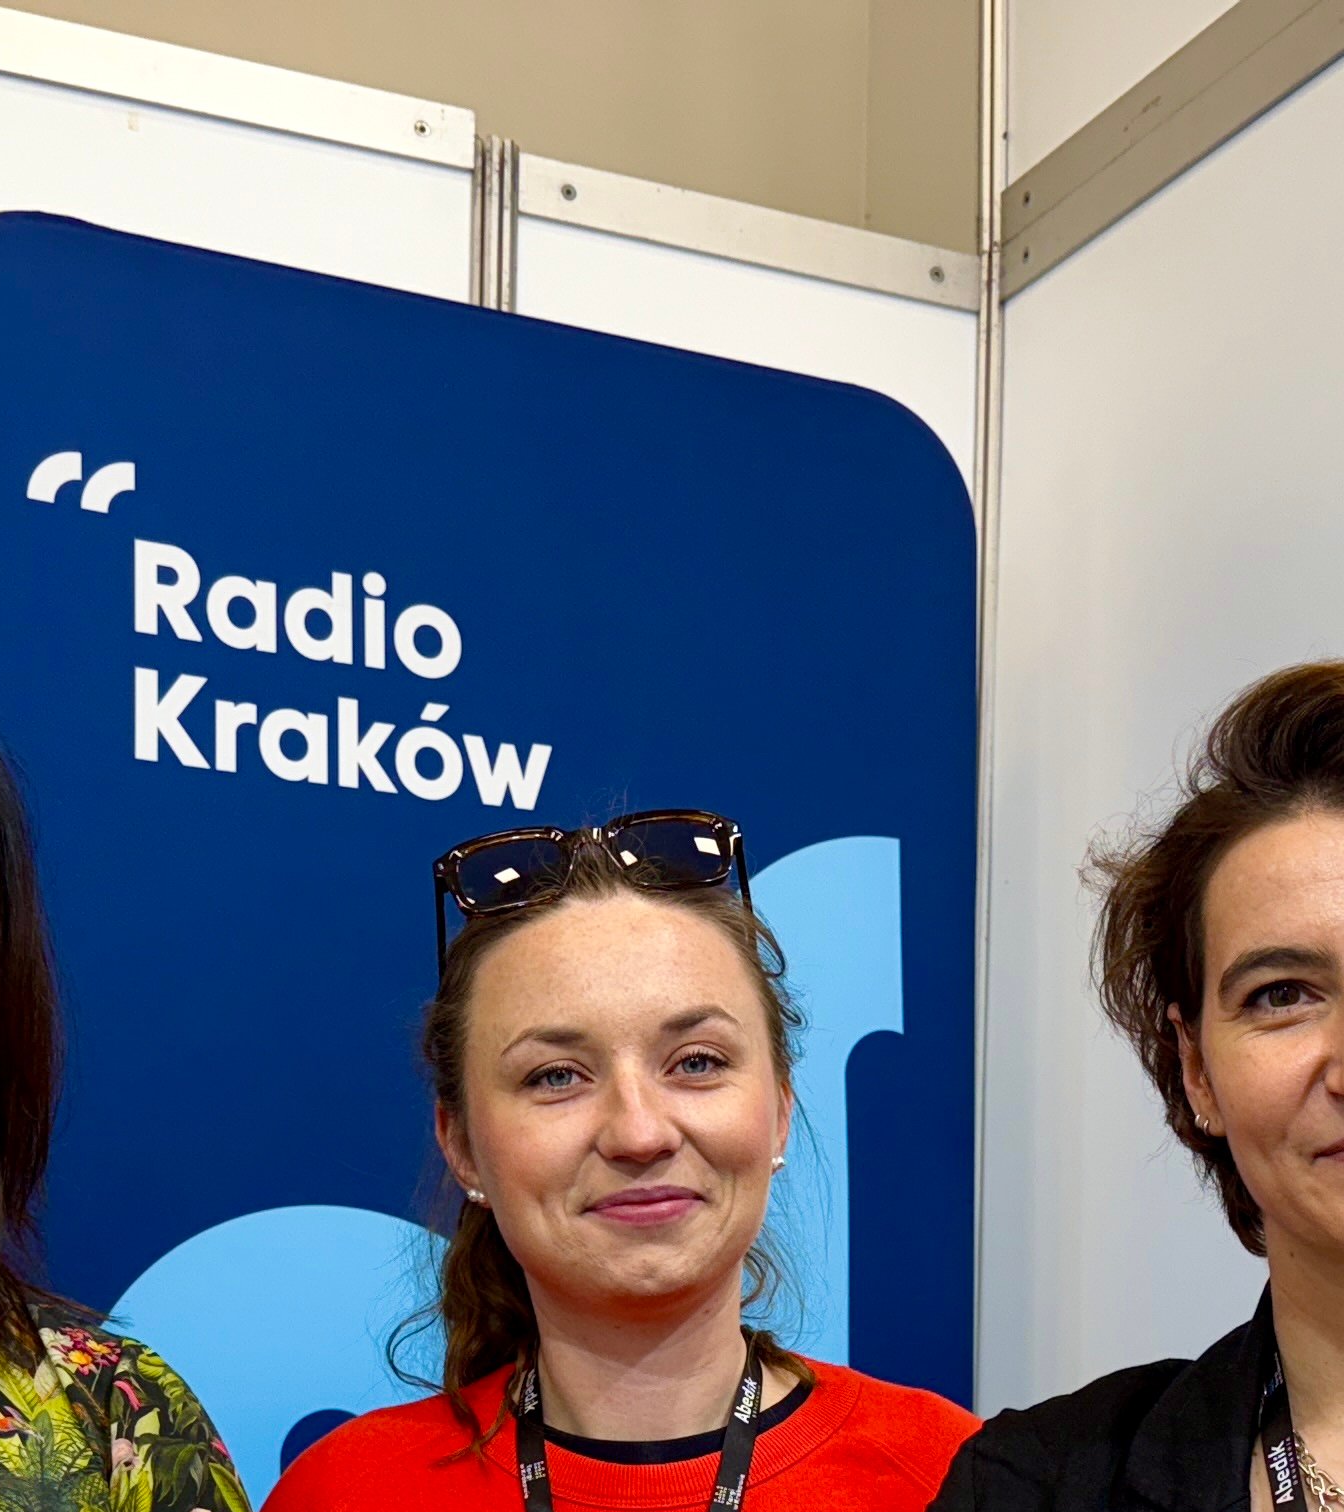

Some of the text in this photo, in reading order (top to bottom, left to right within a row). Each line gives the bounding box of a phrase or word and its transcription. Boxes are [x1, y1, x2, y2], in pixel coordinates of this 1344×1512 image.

[133, 537, 462, 679] Radio
[133, 666, 553, 811] Kraków
[733, 1376, 758, 1424] Abedik
[1267, 1440, 1295, 1505] Abedik
